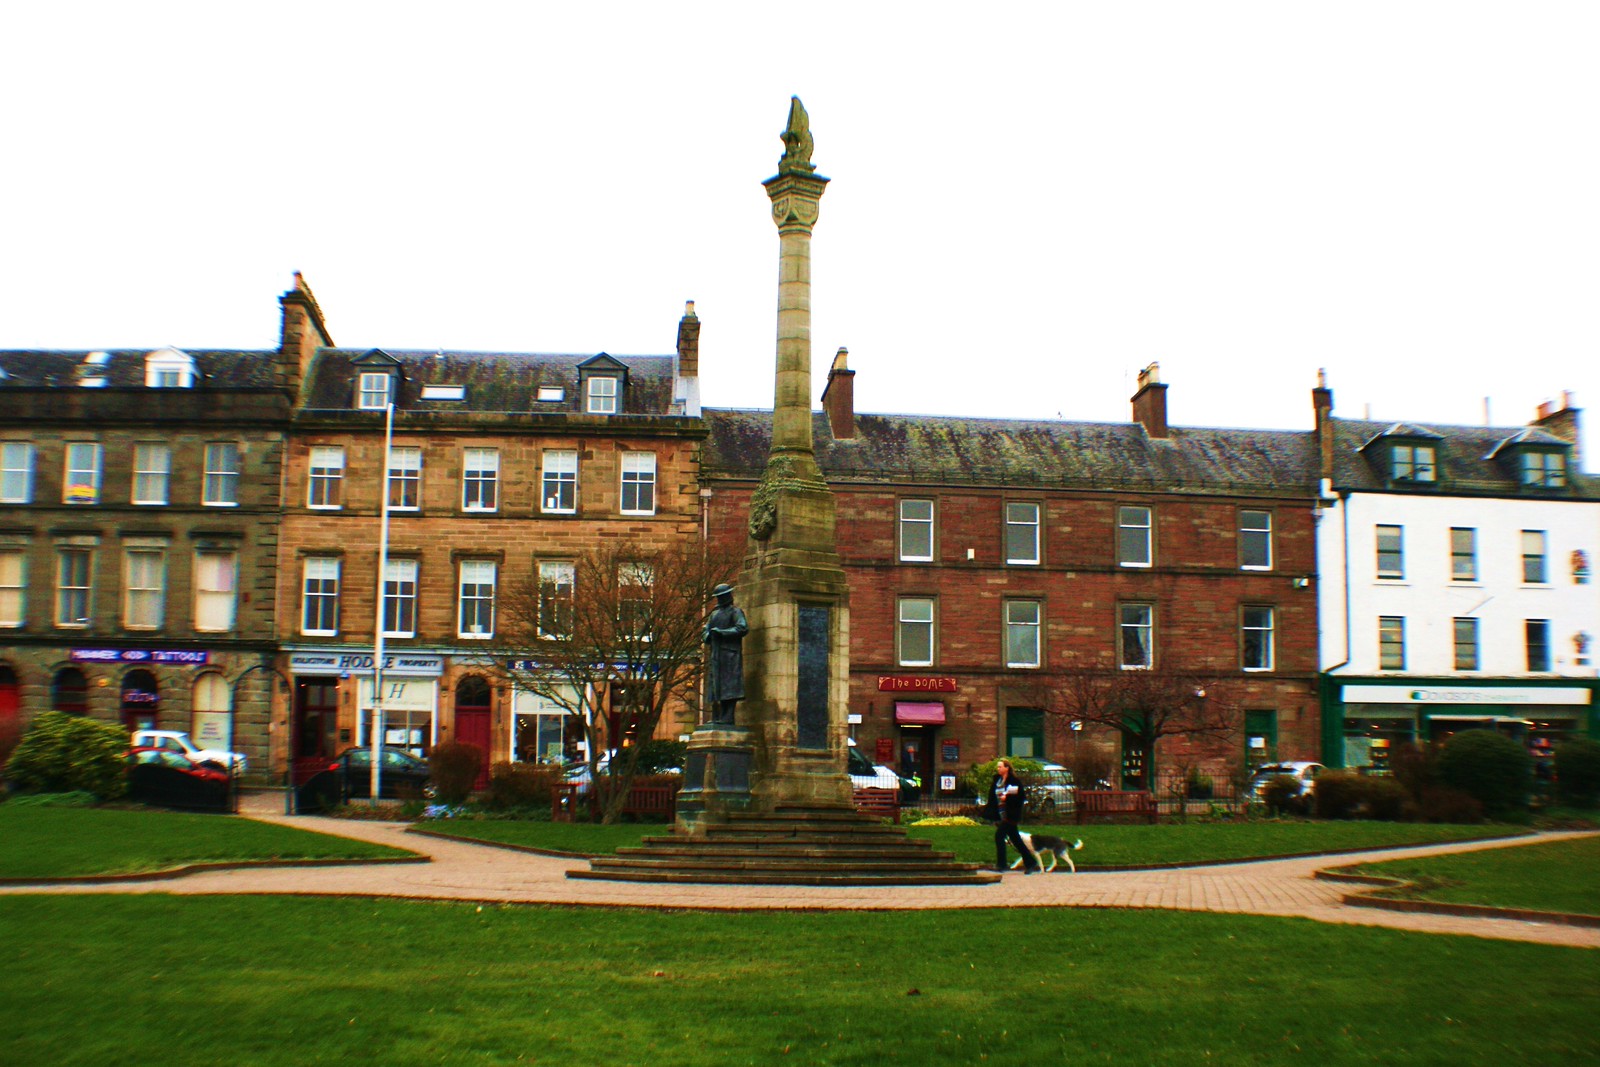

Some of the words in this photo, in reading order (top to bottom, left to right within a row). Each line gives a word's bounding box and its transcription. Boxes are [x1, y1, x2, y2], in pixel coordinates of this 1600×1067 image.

[151, 651, 205, 661] TATTOOS
[339, 656, 394, 668] HODE
[398, 659, 438, 667] PROPERTY
[892, 677, 909, 689] The
[915, 678, 944, 690] DOME
[389, 683, 406, 698] H
